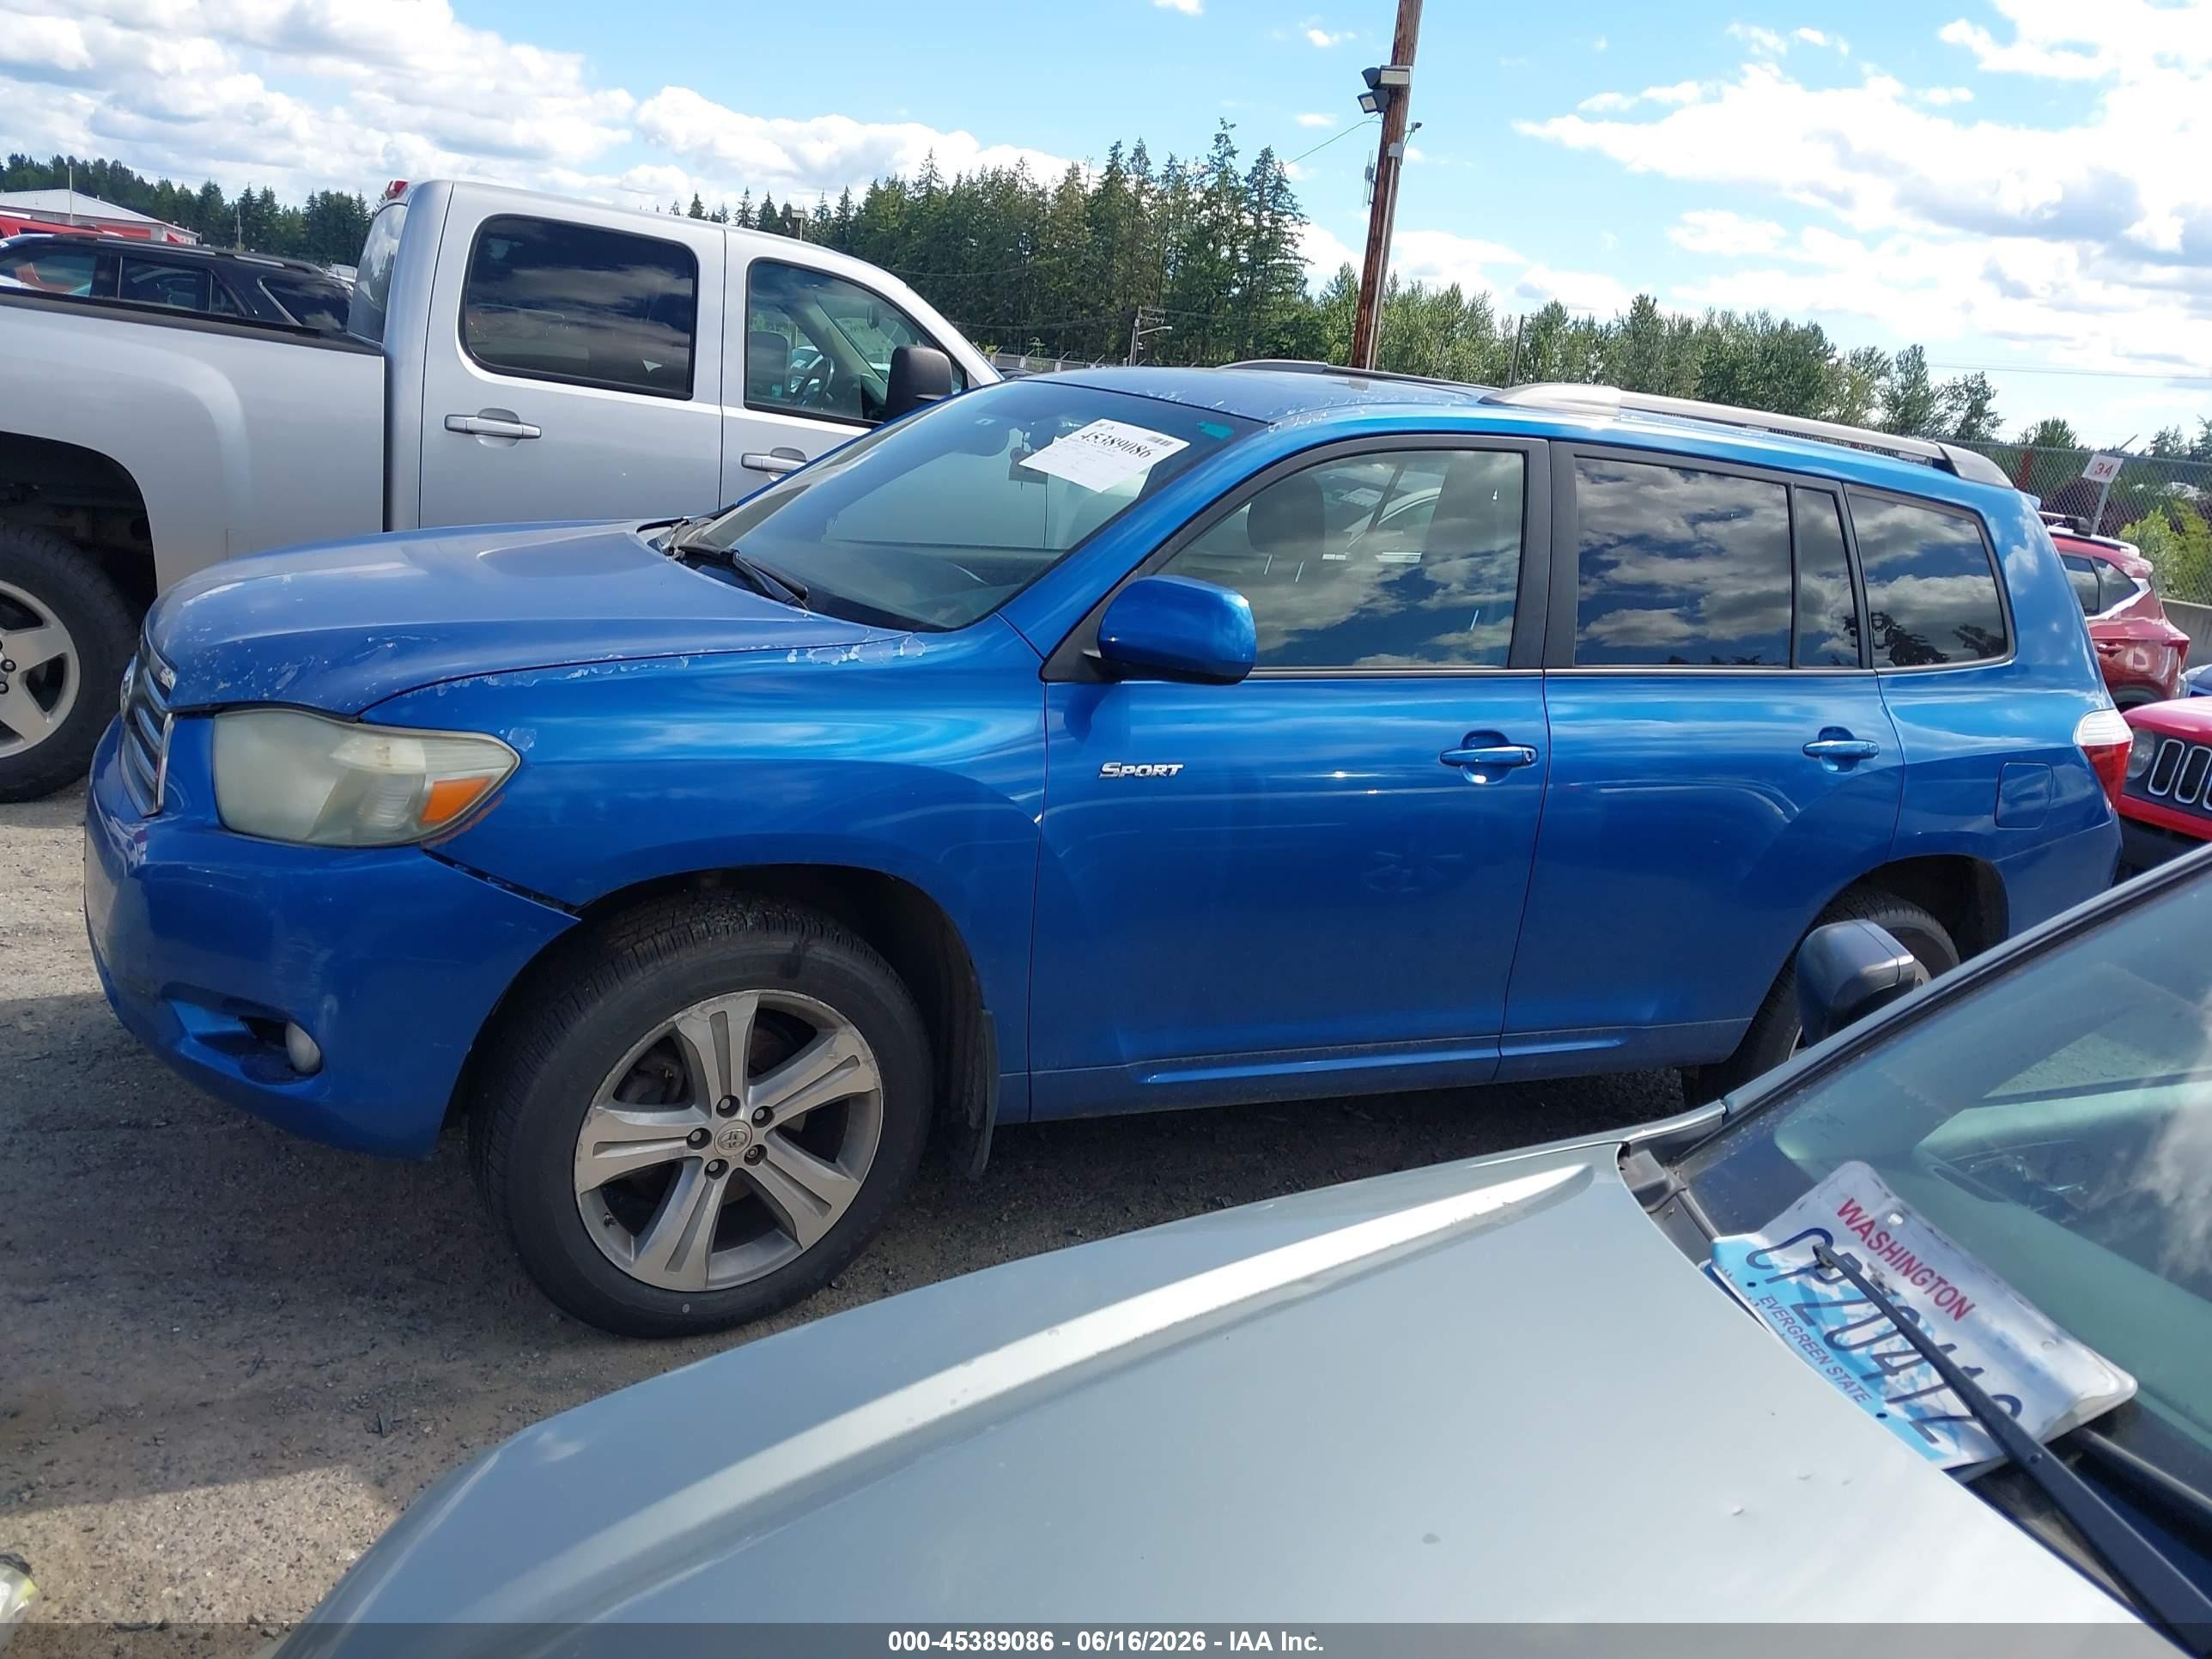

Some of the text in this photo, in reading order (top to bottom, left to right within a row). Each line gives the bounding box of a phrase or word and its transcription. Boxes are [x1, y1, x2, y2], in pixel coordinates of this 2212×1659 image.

[1081, 432, 1152, 459] 45389086
[2095, 462, 2113, 477] 34
[1836, 1197, 1976, 1322] WASHINGTON
[1759, 1295, 1873, 1404] EVERGREEN STATE
